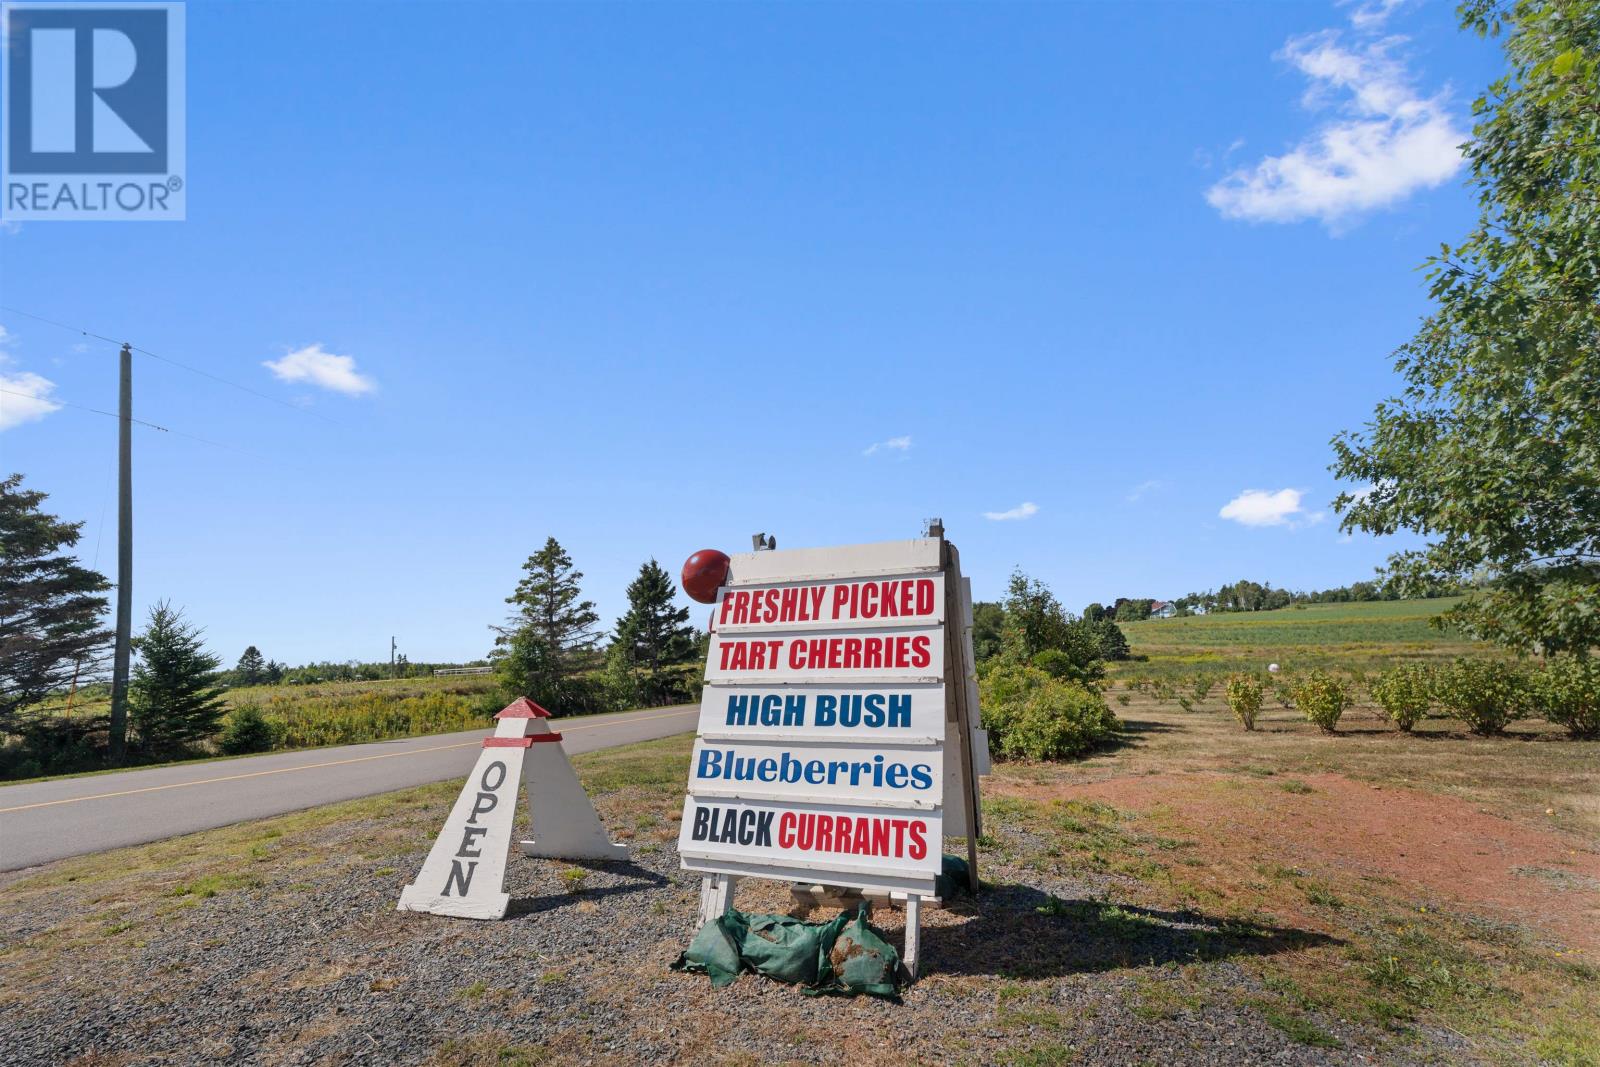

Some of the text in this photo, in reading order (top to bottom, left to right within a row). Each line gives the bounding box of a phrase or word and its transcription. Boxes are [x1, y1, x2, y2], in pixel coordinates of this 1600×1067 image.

[719, 579, 935, 625] FRESHLY PICKED
[719, 635, 931, 671] TART CHERRIES
[726, 694, 912, 728] HIGH BUSH
[696, 749, 933, 790] Blueberries
[440, 760, 507, 897] OPEN
[692, 806, 927, 861] BLACK CURRANTS
